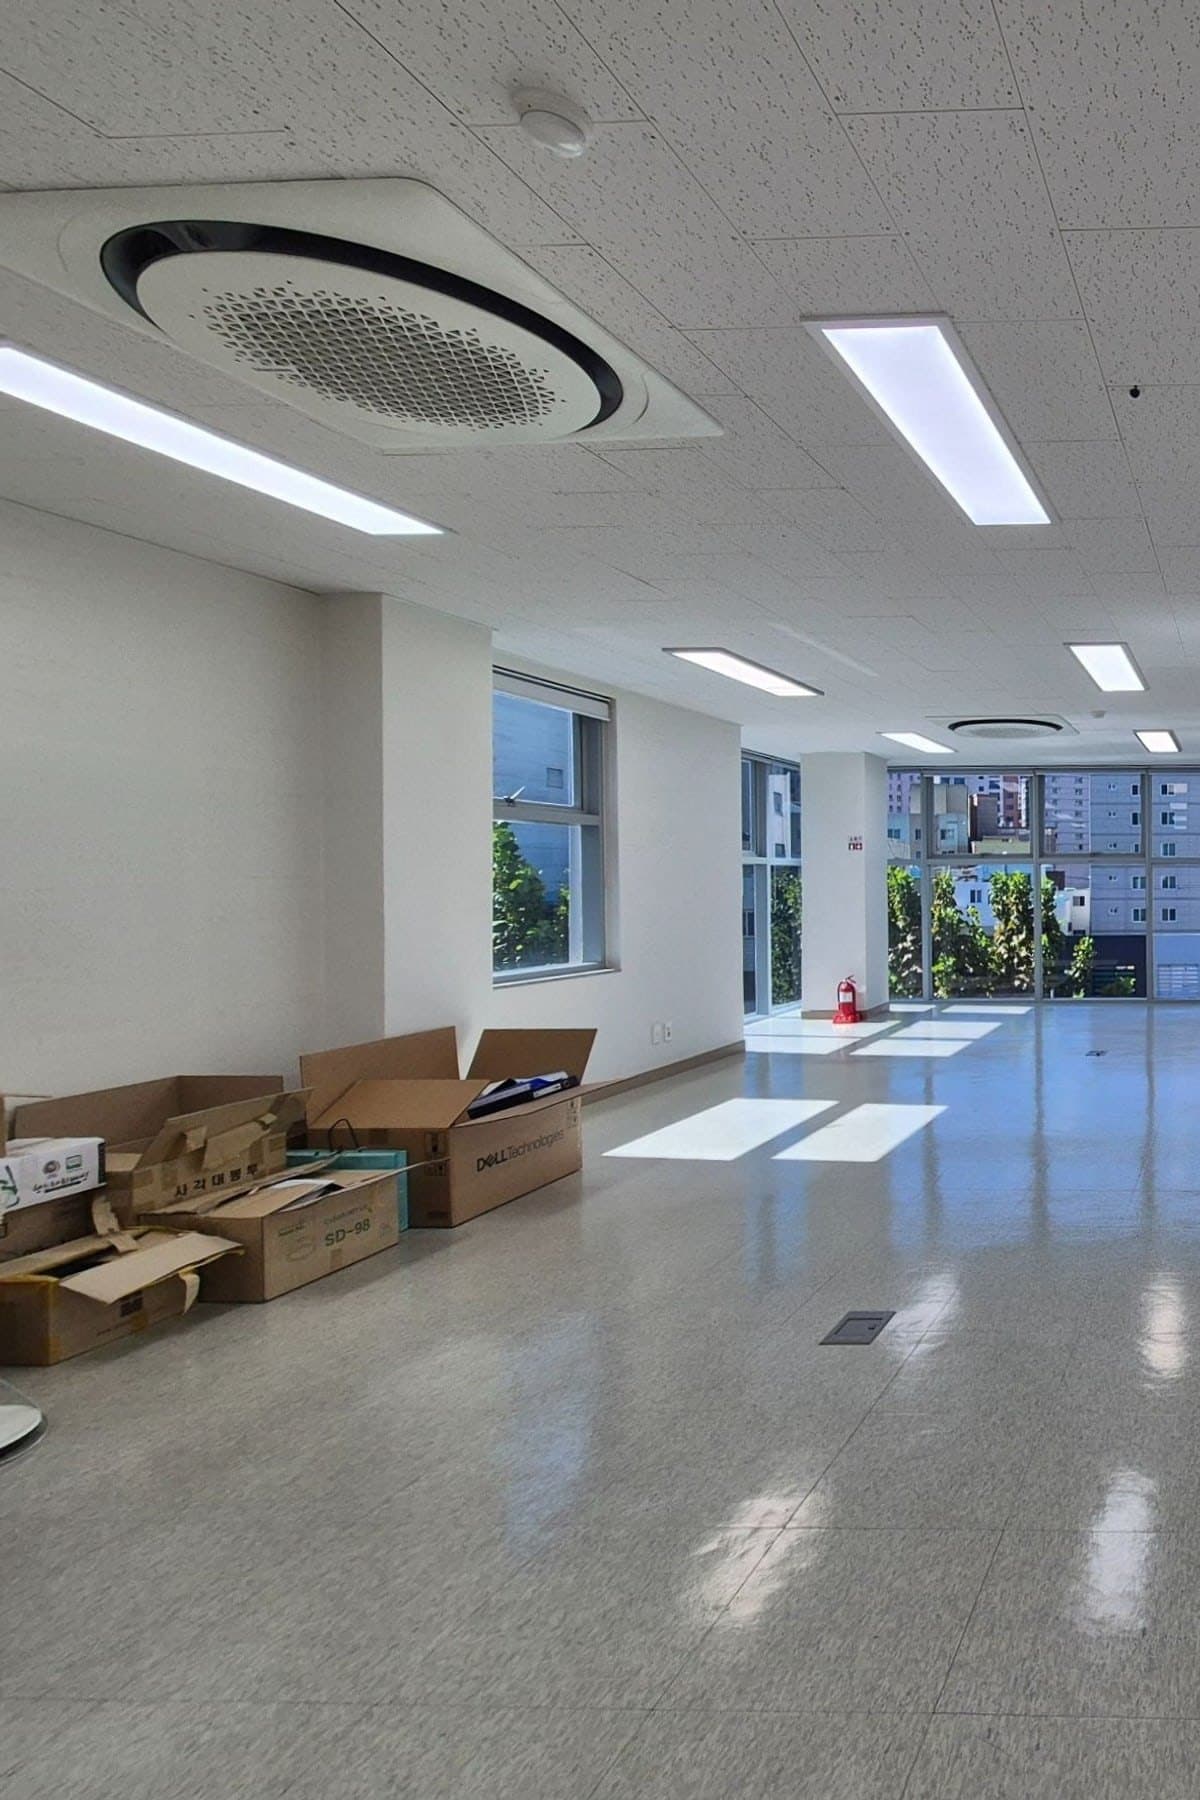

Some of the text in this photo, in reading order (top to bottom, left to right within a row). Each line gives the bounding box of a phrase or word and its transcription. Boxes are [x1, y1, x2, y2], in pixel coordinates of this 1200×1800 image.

[476, 1129, 564, 1172] DELL Technologies
[325, 1218, 371, 1246] SD-98
